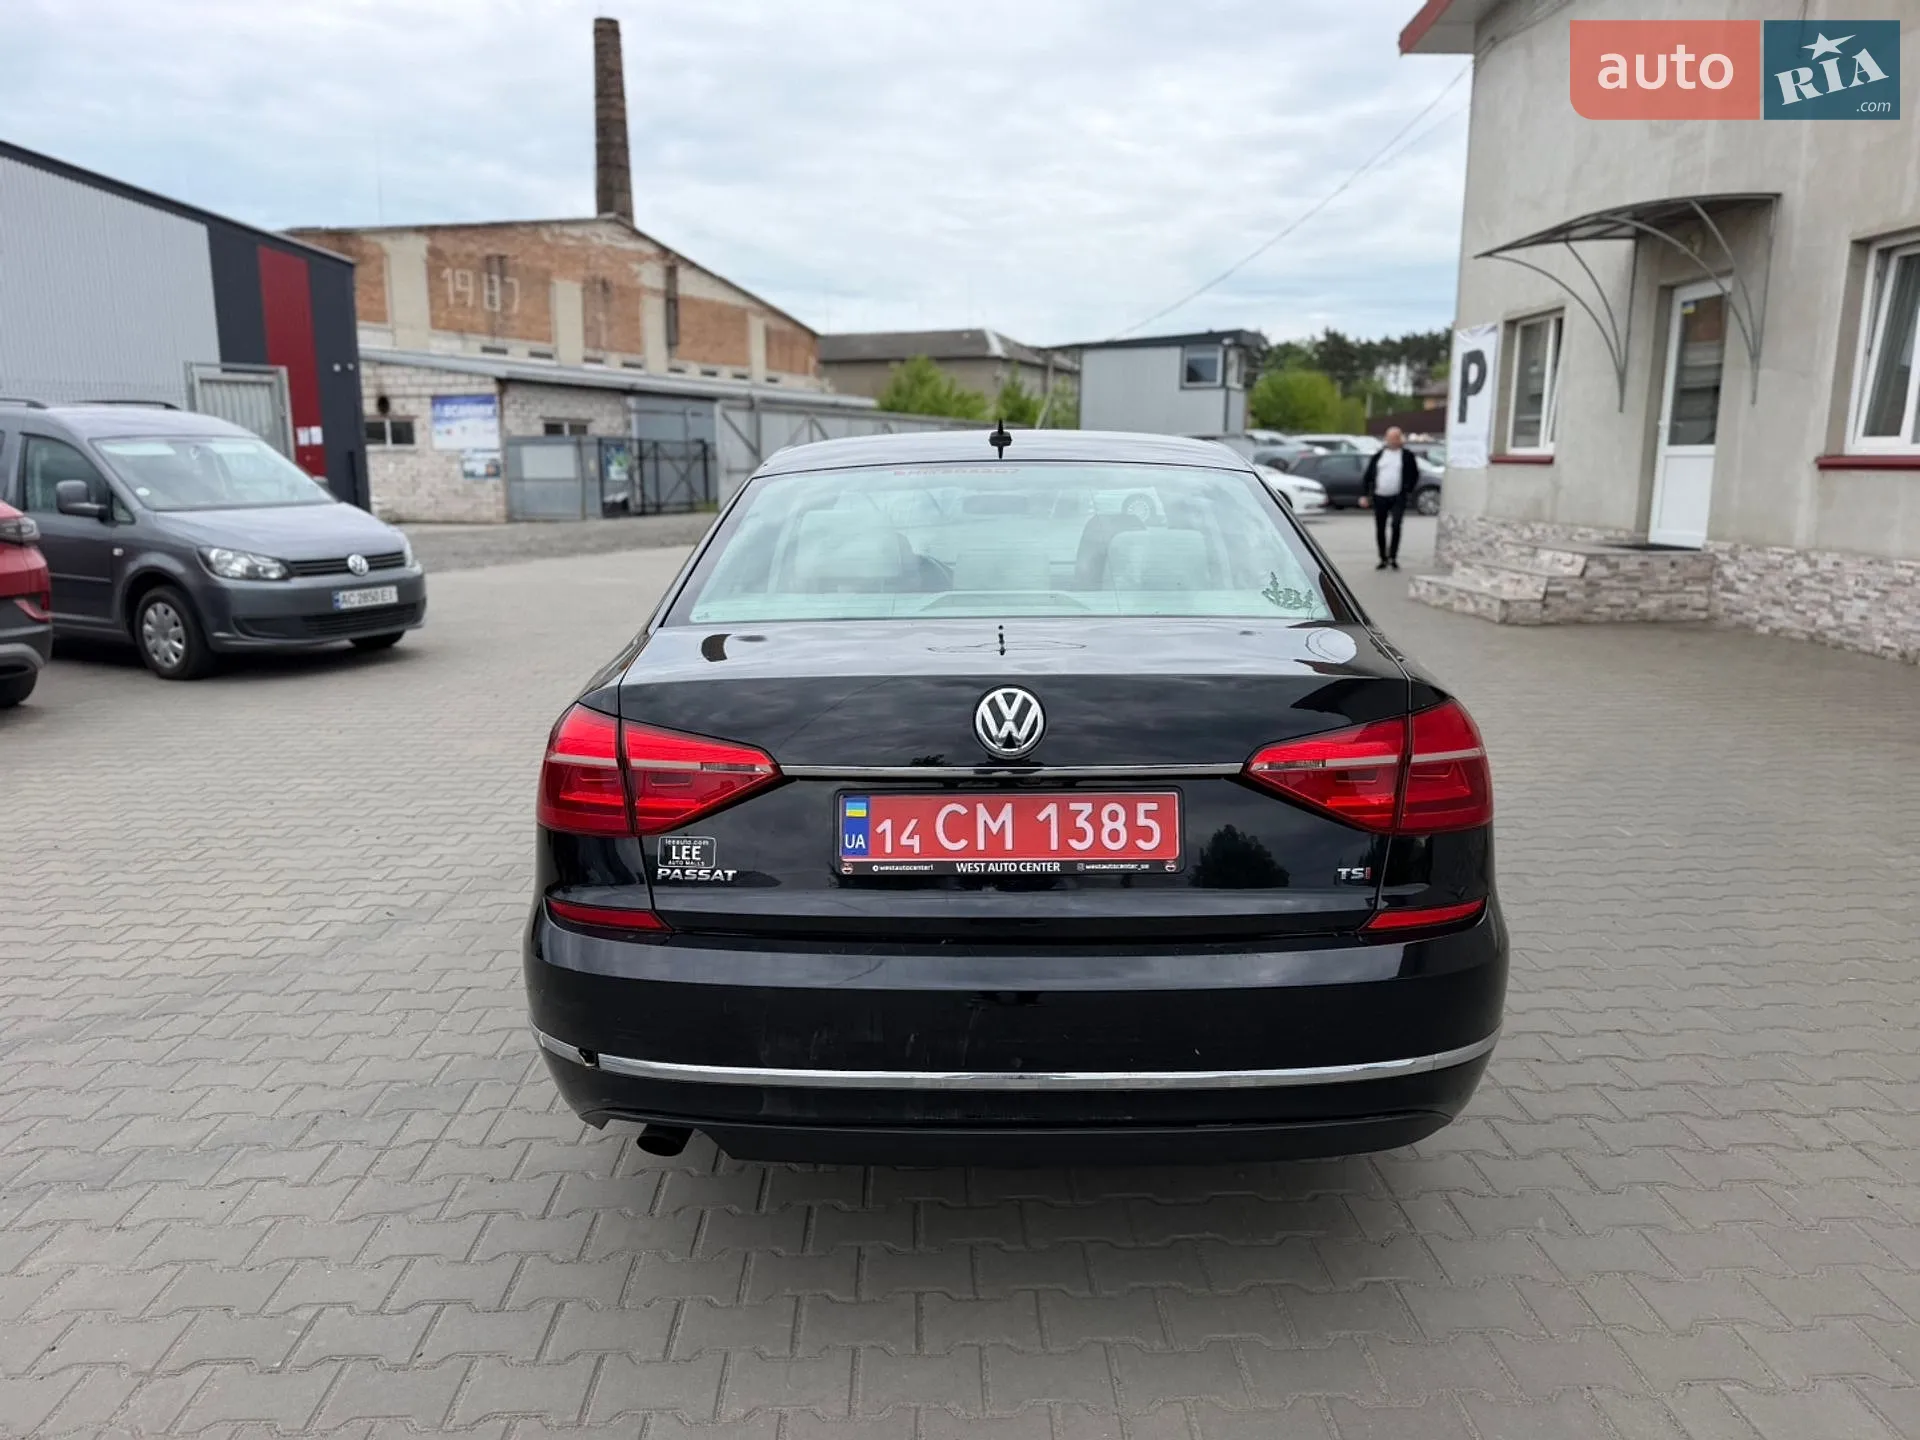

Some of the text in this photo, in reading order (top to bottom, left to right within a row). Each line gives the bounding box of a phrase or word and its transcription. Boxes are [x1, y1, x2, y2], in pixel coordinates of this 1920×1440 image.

[440, 267, 521, 315] 1987
[1457, 348, 1488, 424] P
[977, 688, 1043, 754] VW
[875, 801, 1162, 854] 14 CM 1385
[845, 833, 867, 850] UA
[672, 846, 702, 860] LEE
[657, 868, 737, 881] PASSAT
[955, 861, 1061, 873] WEST AUTO CENTER
[1336, 866, 1372, 881] TSI
